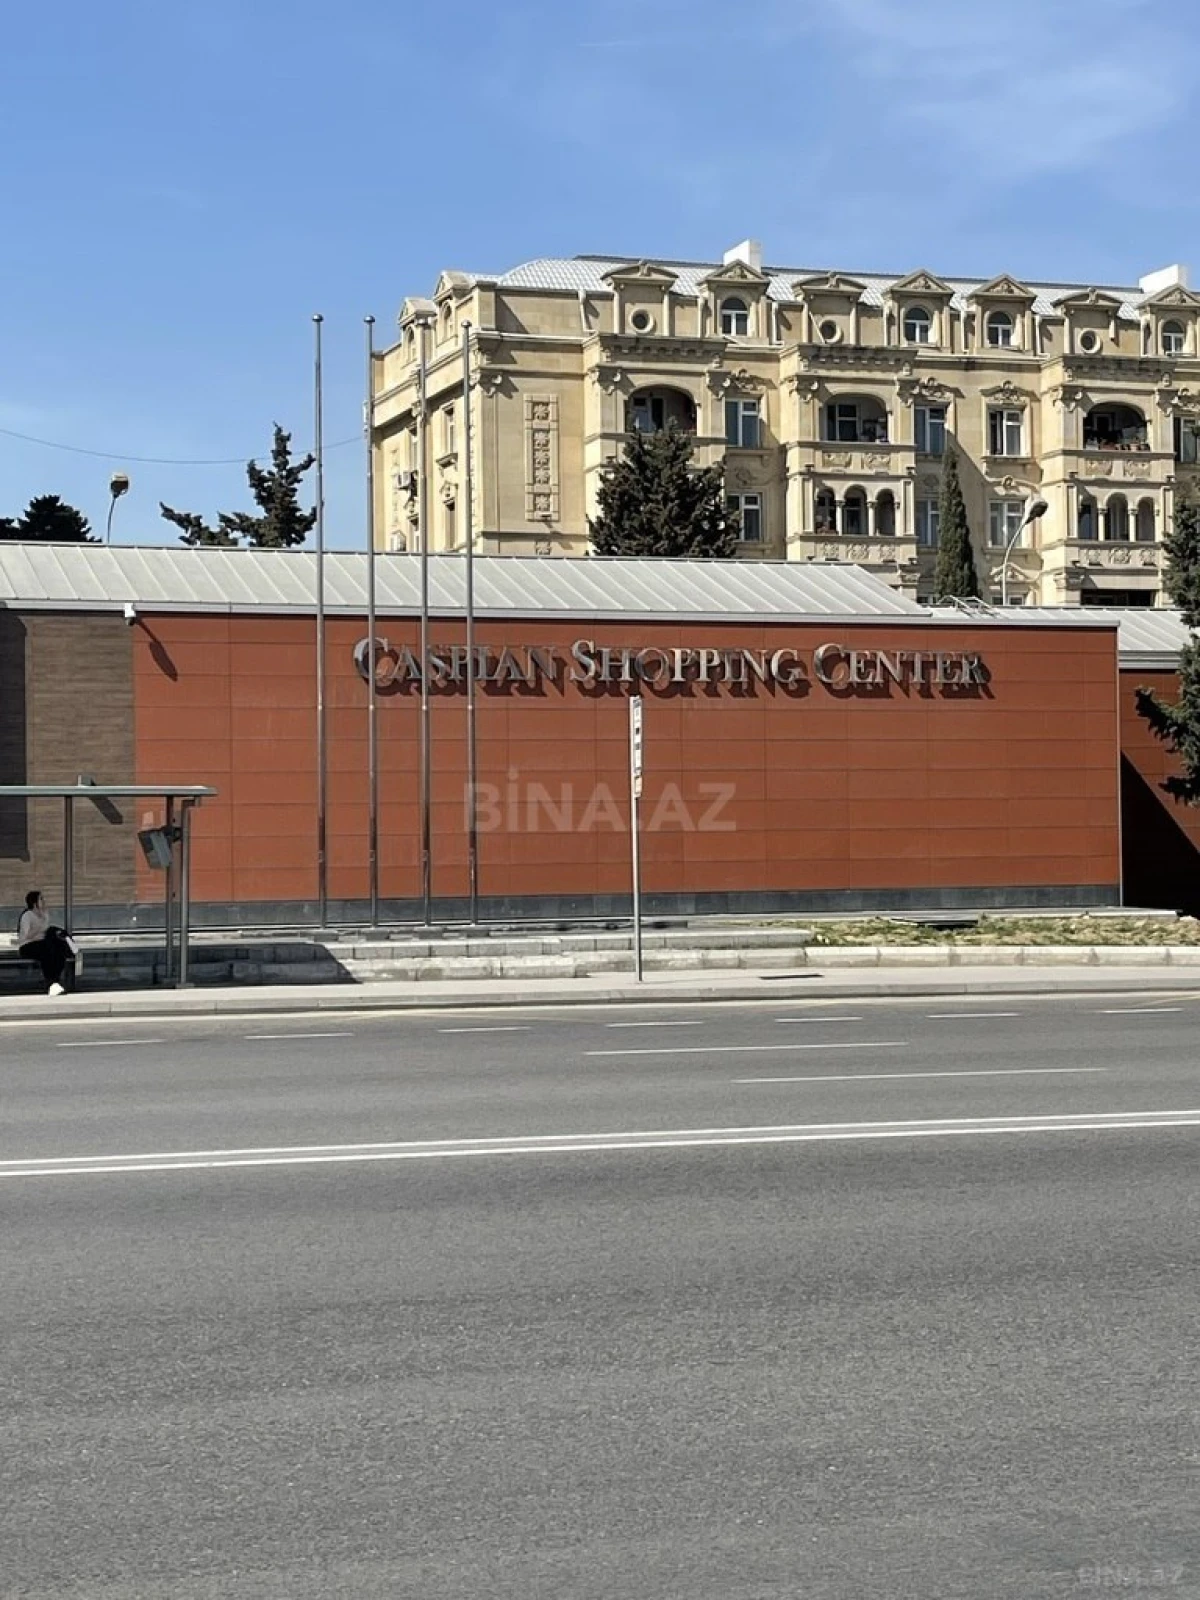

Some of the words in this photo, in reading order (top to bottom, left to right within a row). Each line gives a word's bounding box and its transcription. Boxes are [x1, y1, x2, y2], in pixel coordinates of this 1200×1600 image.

[353, 637, 559, 681] CASPIAN
[569, 639, 807, 684] SHOPPING
[813, 643, 987, 684] CENTER
